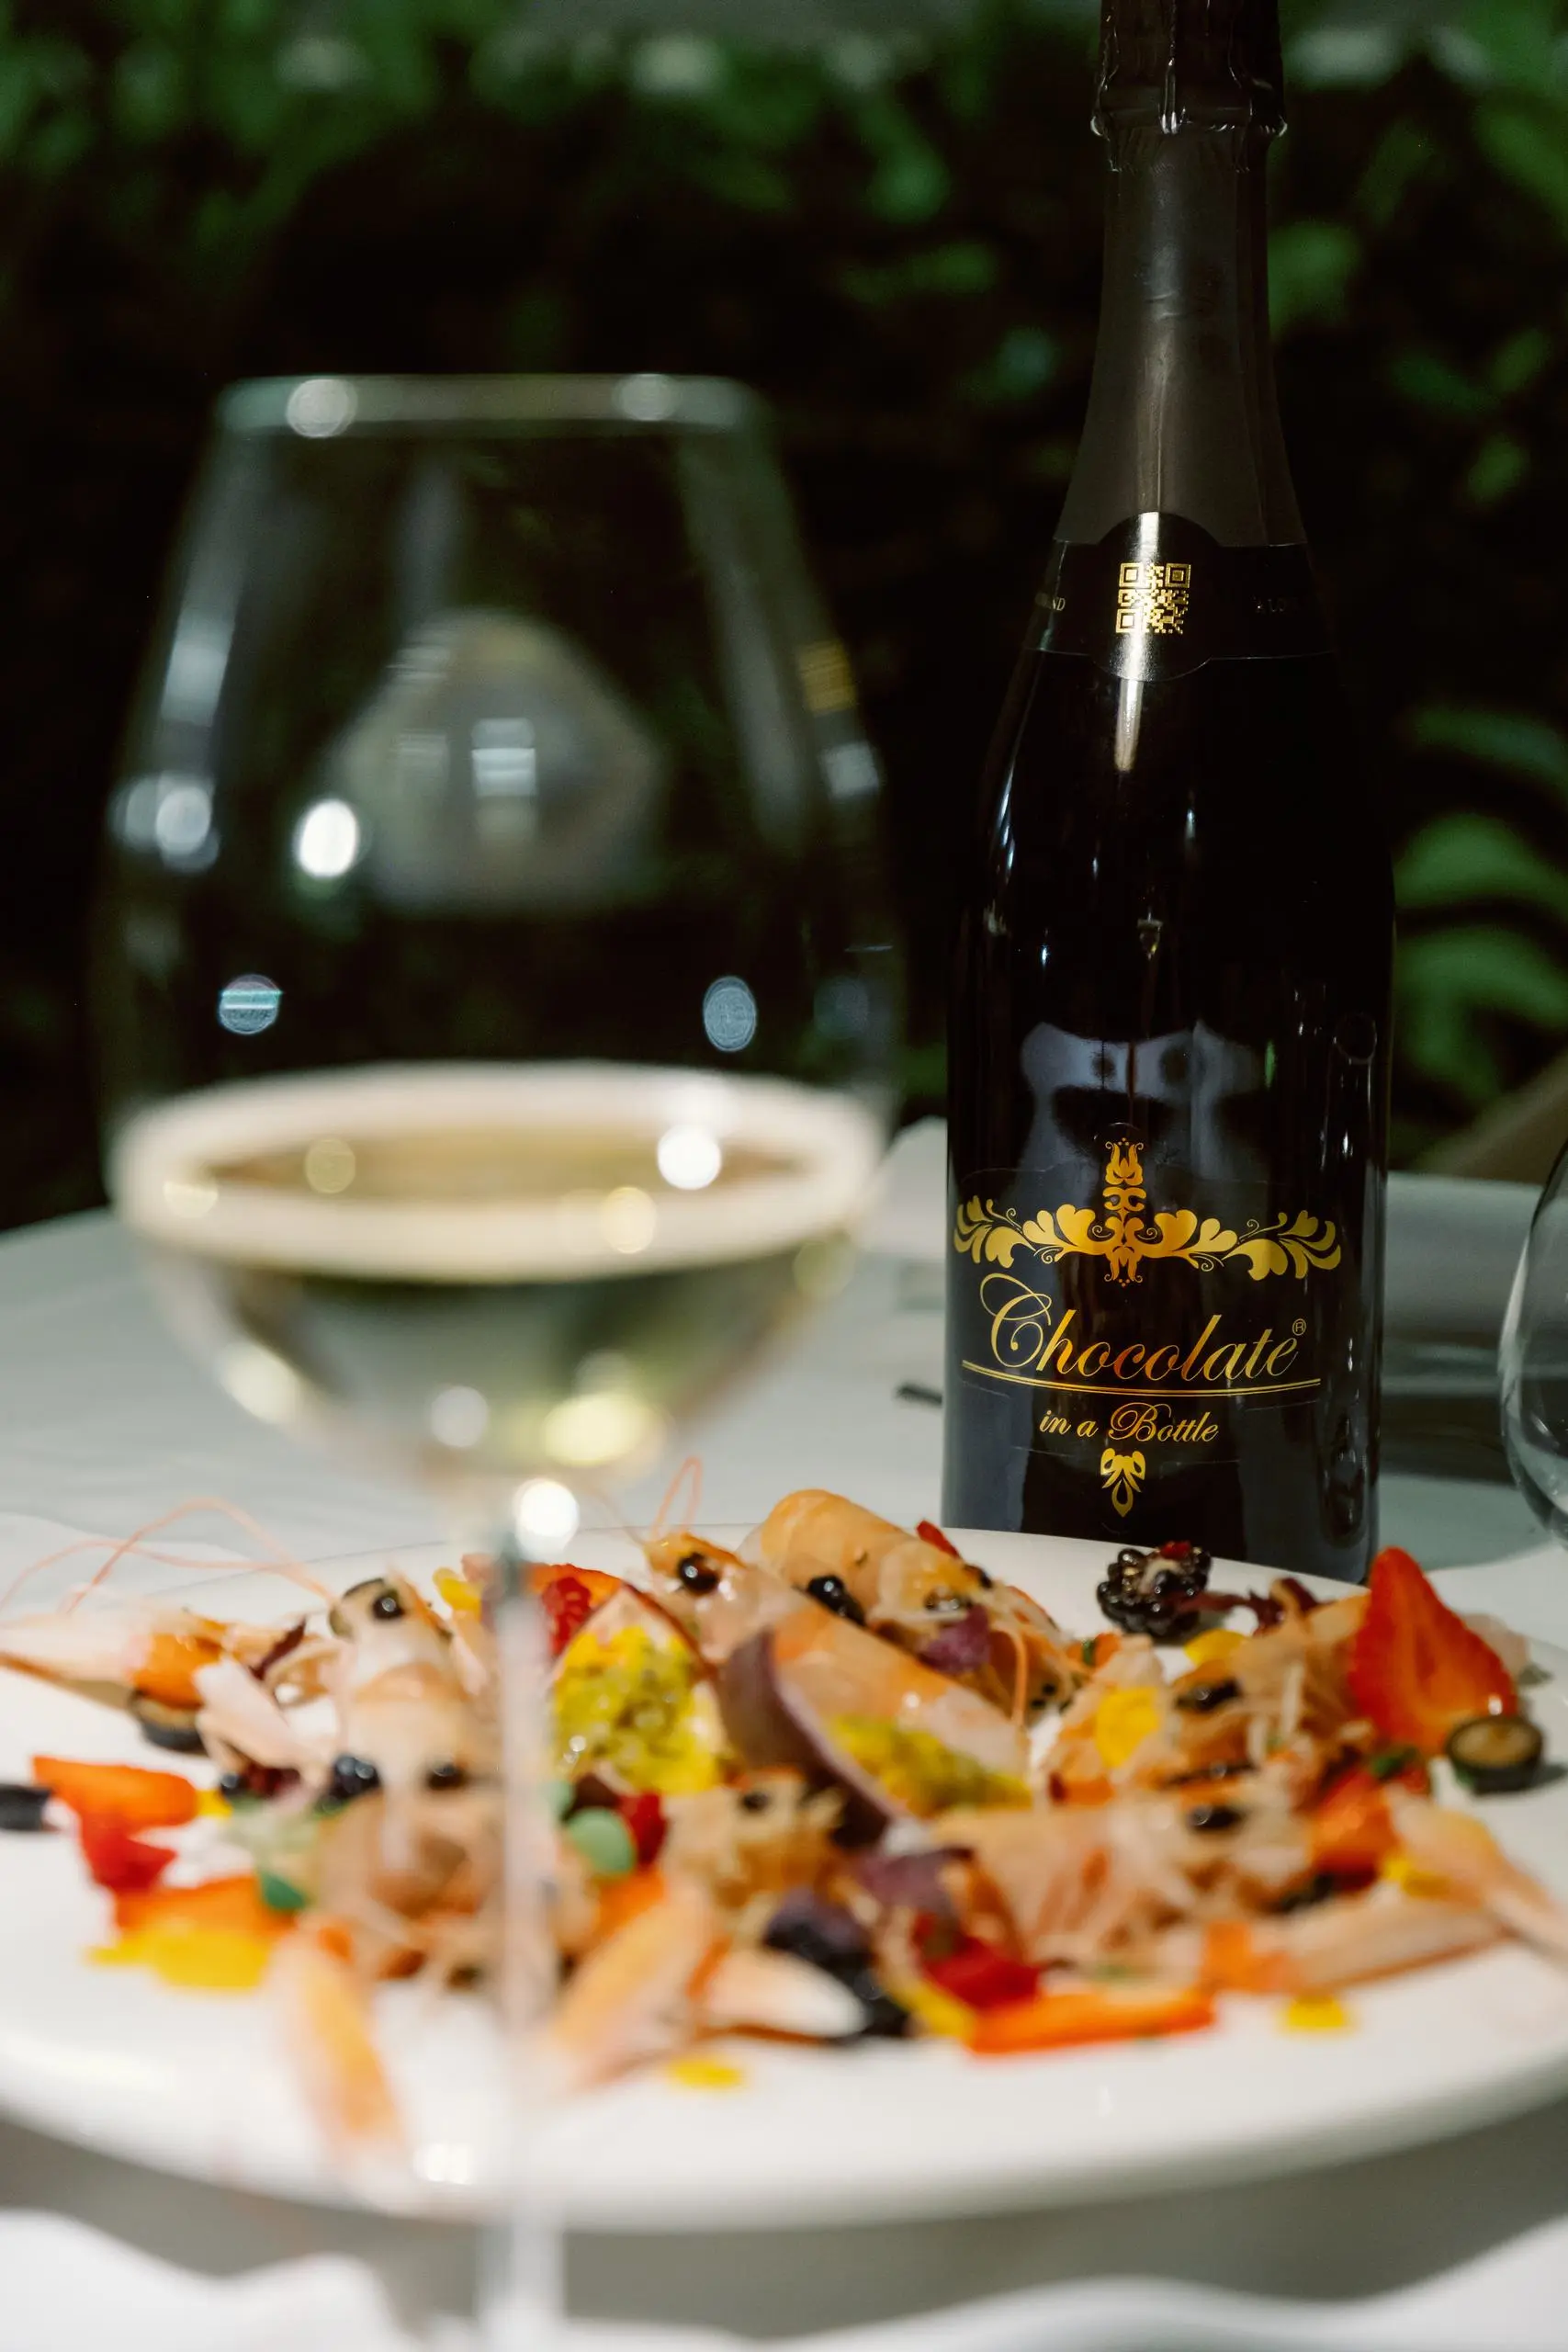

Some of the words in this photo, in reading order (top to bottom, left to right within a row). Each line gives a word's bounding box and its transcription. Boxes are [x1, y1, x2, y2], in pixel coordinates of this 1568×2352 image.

[1039, 1409, 1072, 1435] in
[1077, 1419, 1099, 1438] a
[1108, 1401, 1219, 1442] Bottle
